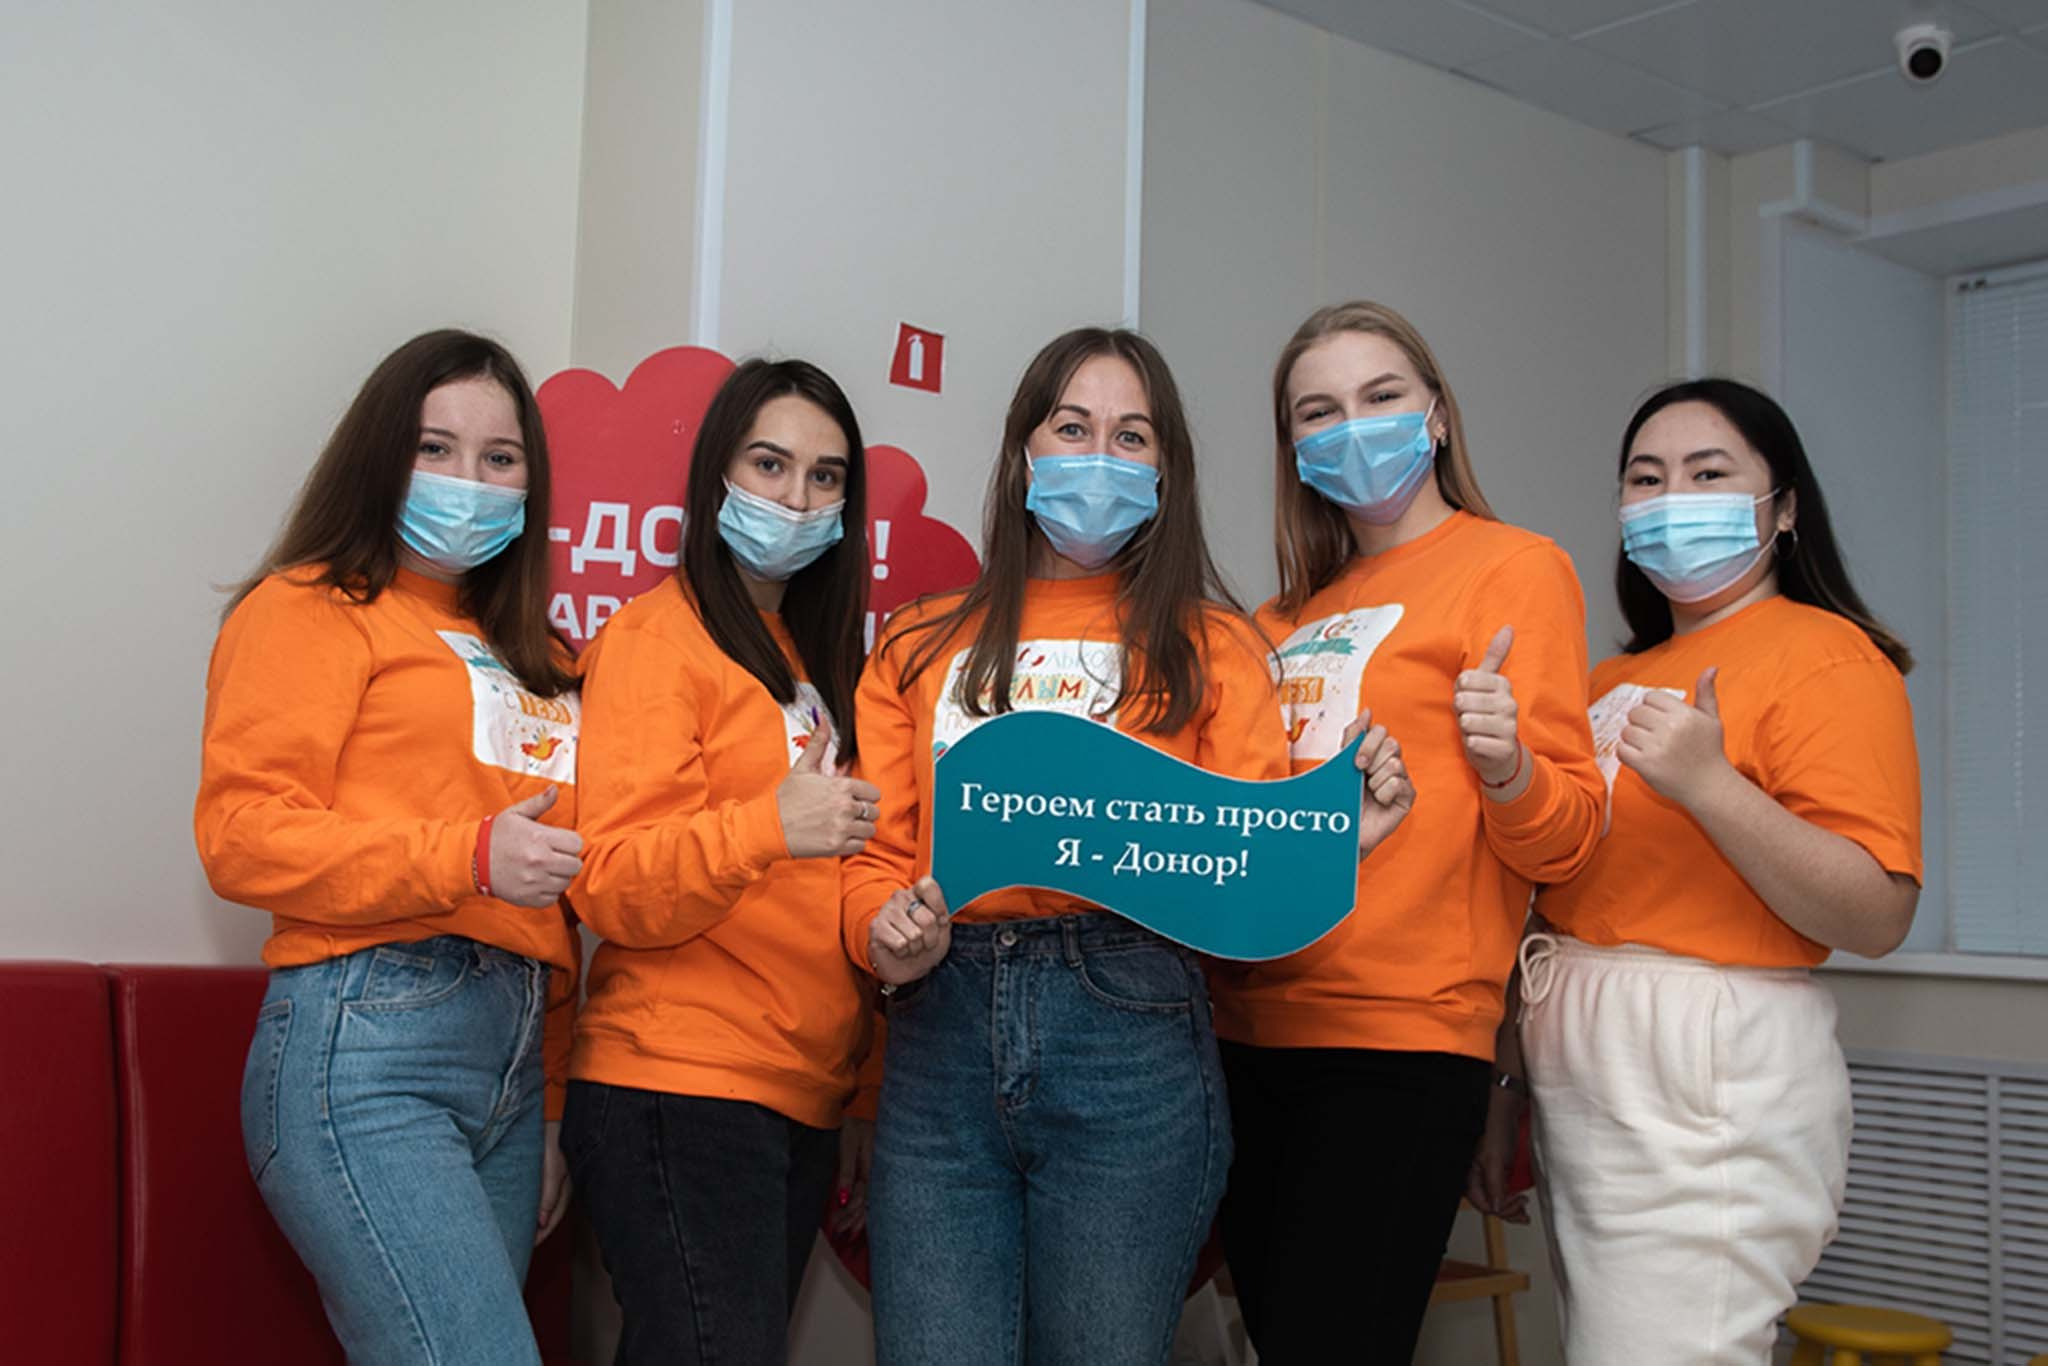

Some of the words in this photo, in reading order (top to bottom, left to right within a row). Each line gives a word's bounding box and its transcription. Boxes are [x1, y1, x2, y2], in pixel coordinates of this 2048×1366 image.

[960, 782, 1096, 823] Героем
[1105, 799, 1206, 826] стать
[1215, 805, 1351, 838] просто
[1055, 838, 1083, 867] Я
[1091, 853, 1104, 862] -
[1112, 841, 1249, 886] Донор!
